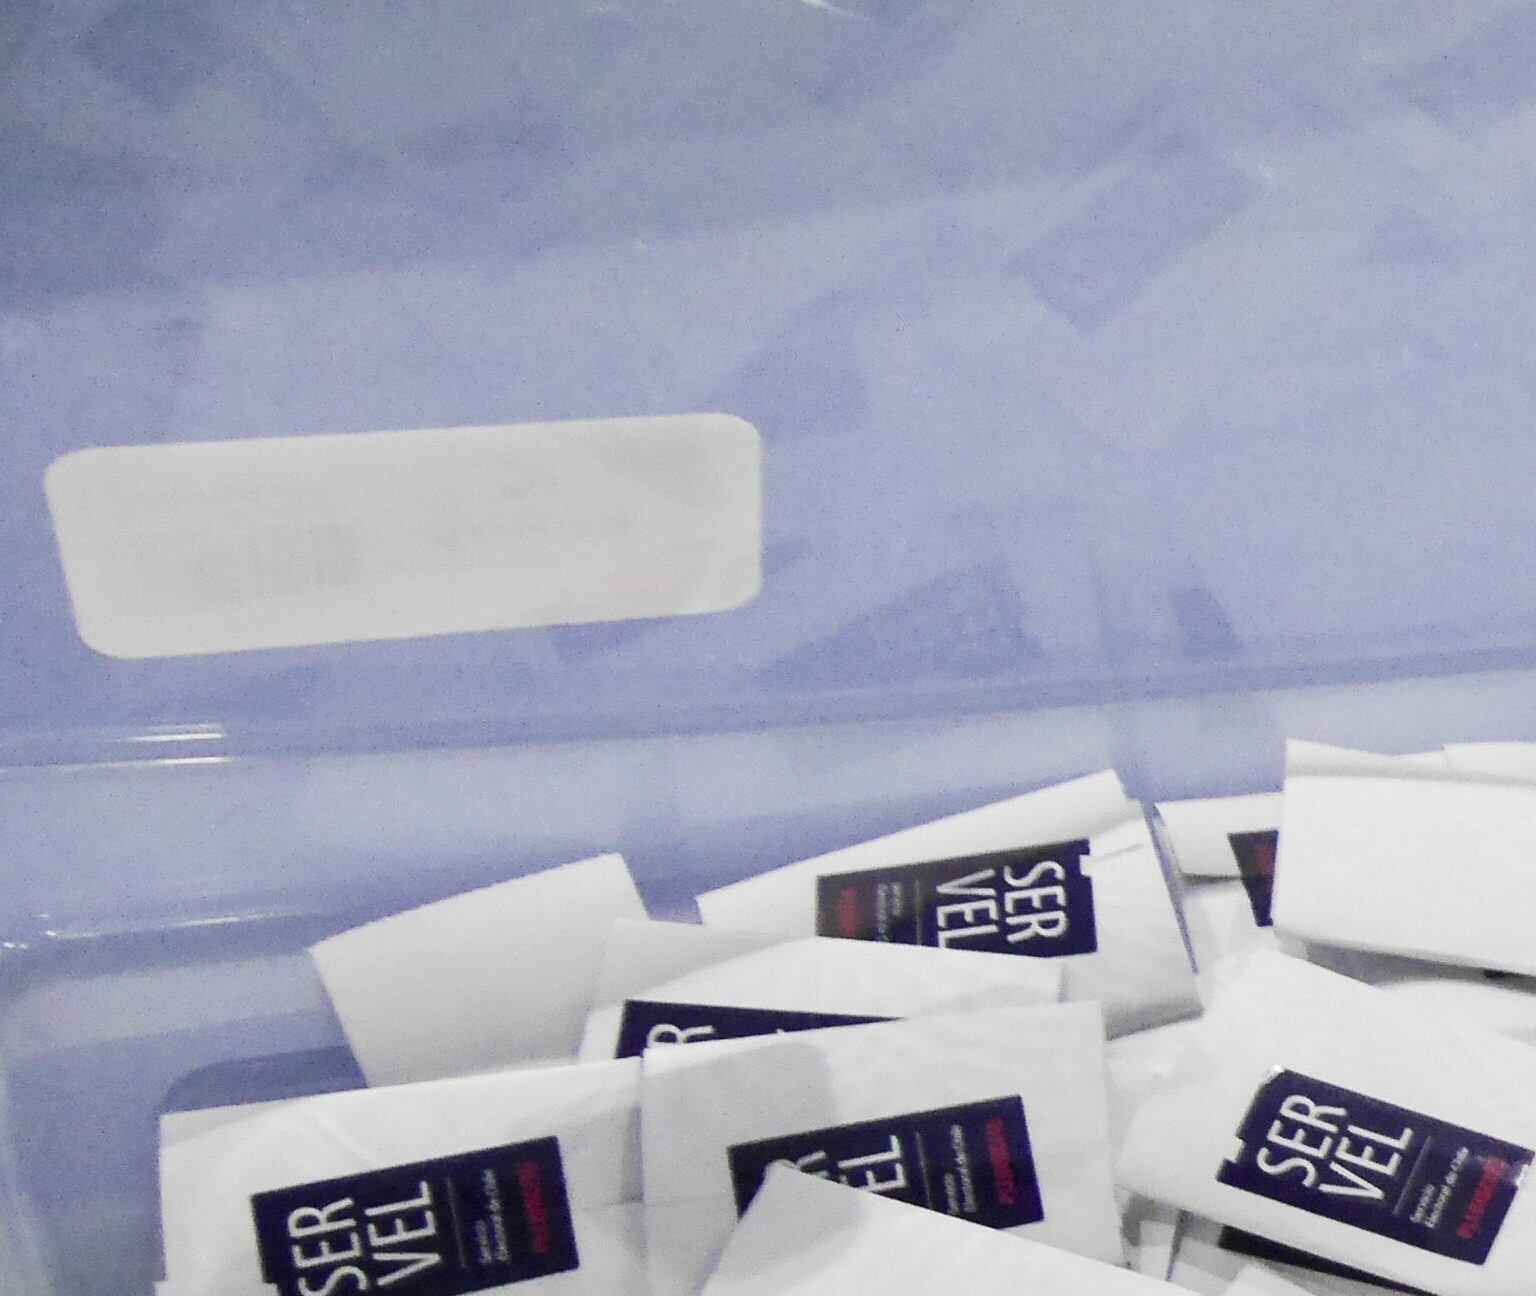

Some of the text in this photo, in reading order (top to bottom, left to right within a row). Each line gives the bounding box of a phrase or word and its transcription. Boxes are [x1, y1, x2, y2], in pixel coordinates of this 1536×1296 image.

[935, 868, 999, 951] VEL
[1003, 860, 1068, 943] SER
[837, 1134, 907, 1191] EL
[1256, 1094, 1348, 1188] SER
[1318, 1124, 1414, 1200] VEL
[367, 1180, 443, 1288] VEL
